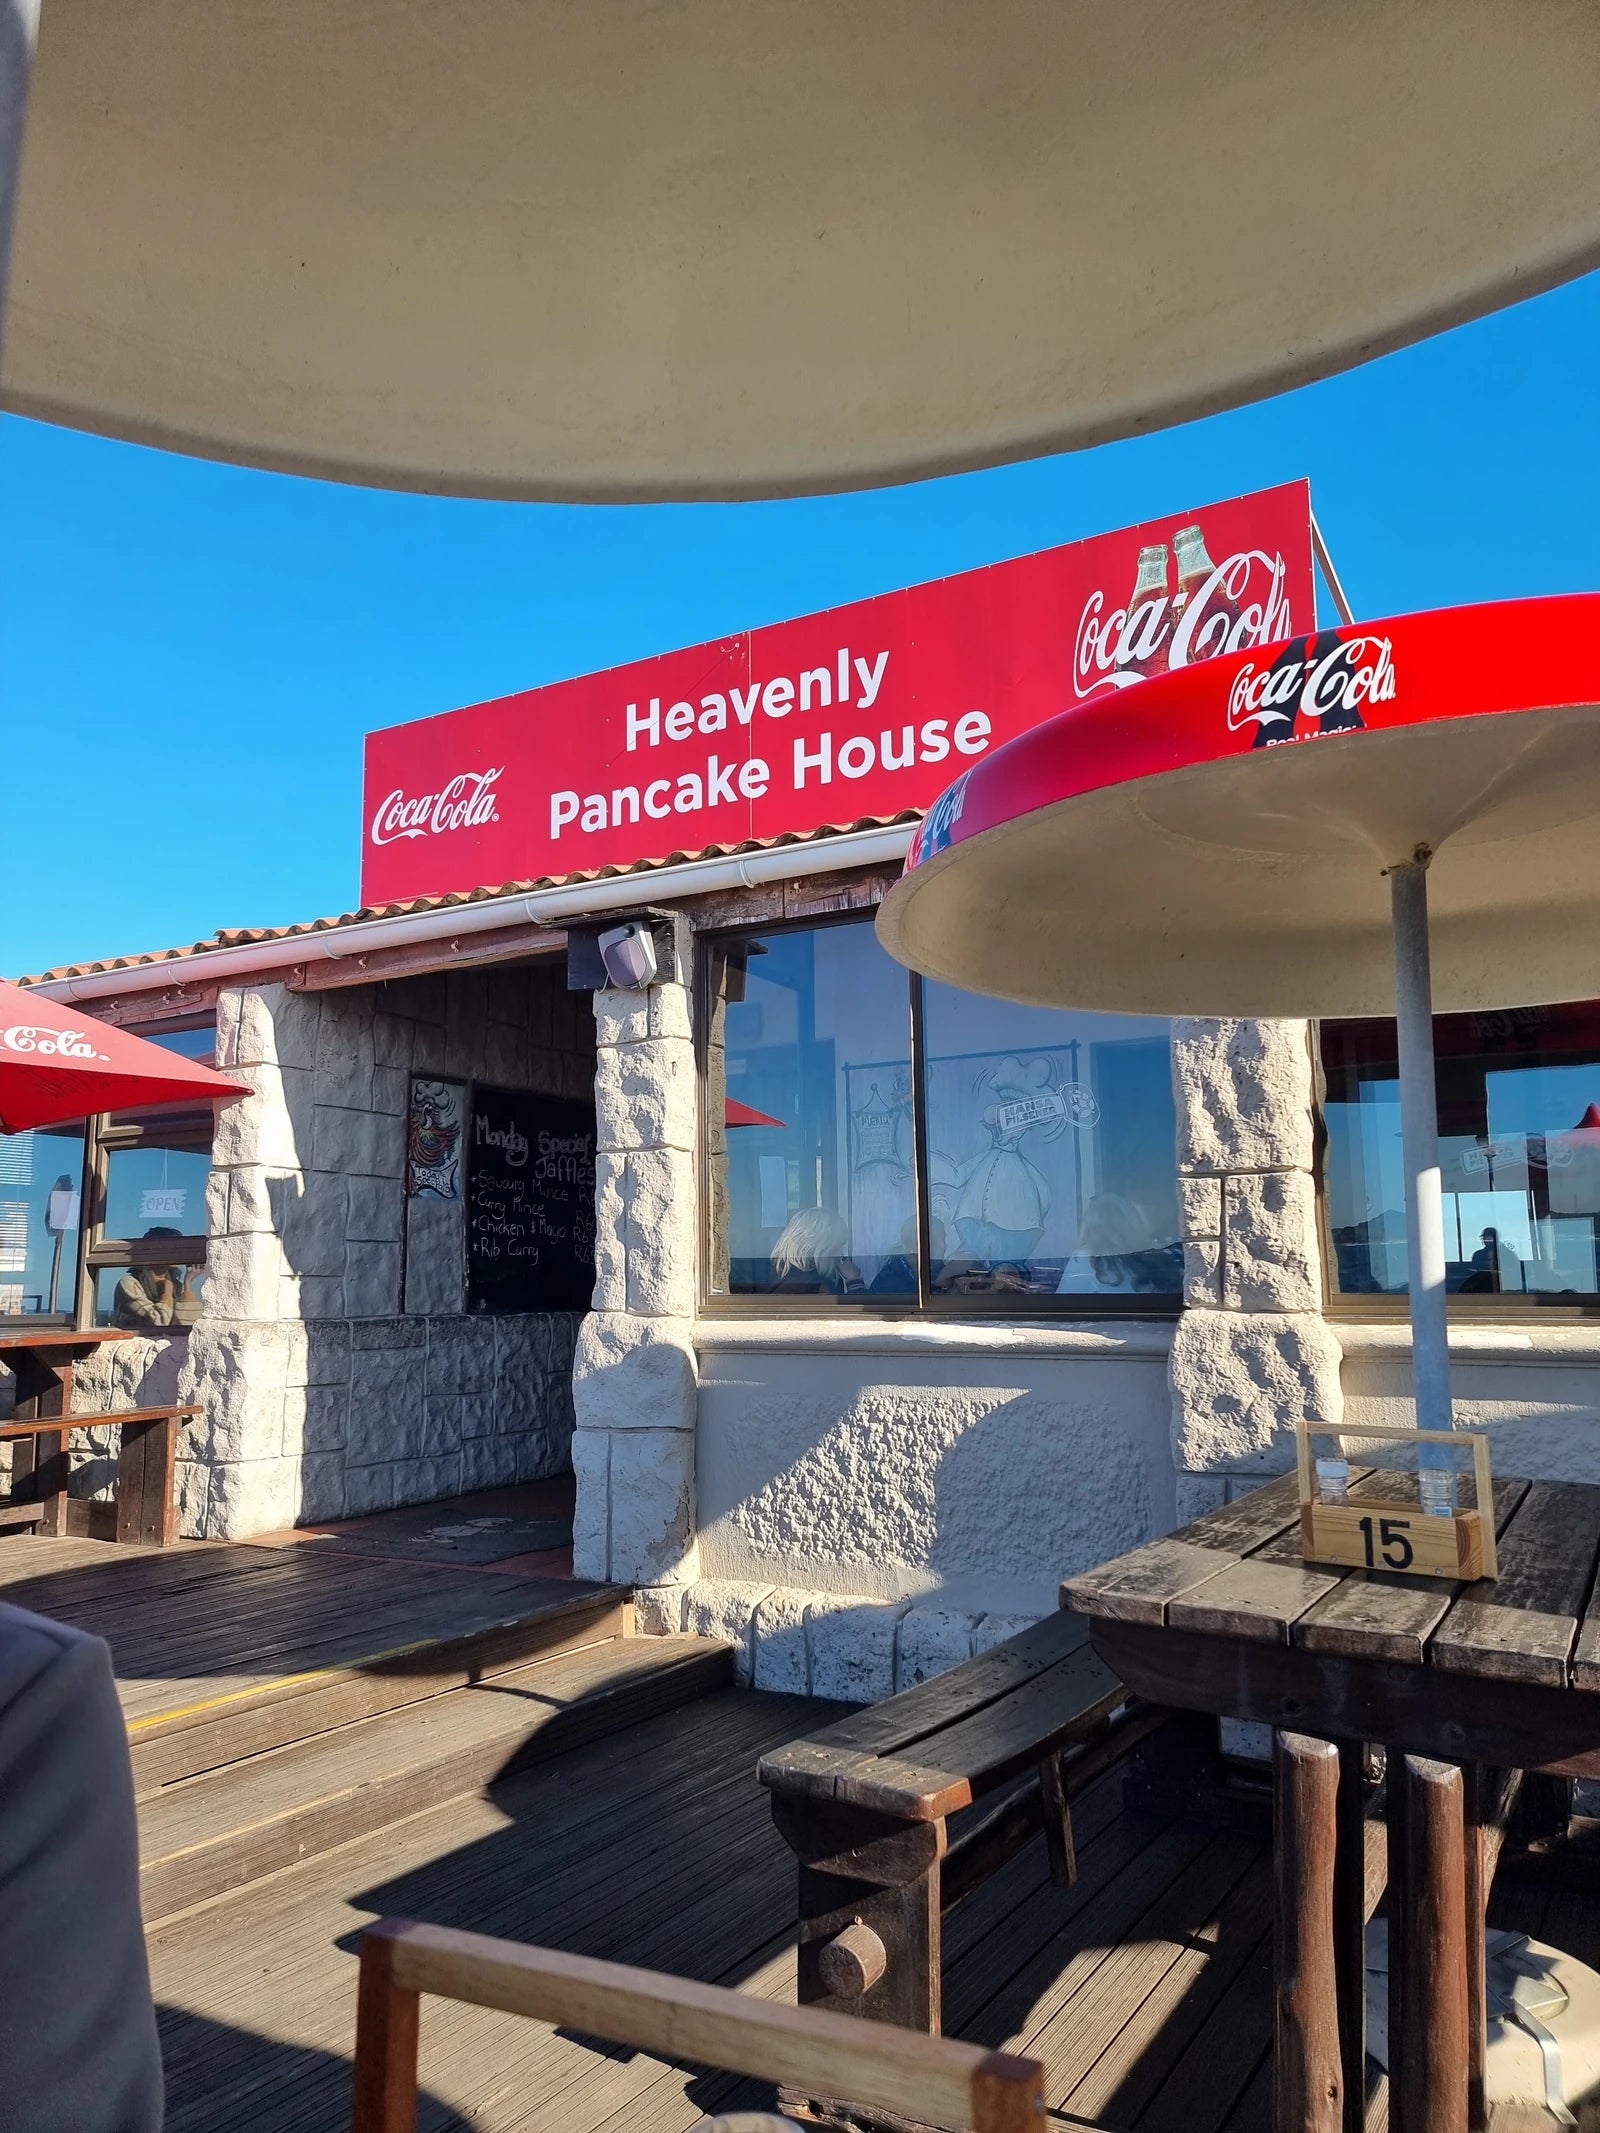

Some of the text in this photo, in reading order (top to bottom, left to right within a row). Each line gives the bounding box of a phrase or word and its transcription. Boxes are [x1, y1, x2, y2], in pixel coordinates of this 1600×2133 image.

[1073, 550, 1292, 698] Coca-Cola
[625, 647, 889, 753] Heavenly
[1227, 637, 1397, 732] Coca-Cola
[549, 709, 992, 840] Pancake House
[371, 765, 505, 846] Coca-Cola
[1004, 1098, 1055, 1118] HANSA
[476, 1114, 529, 1167] Monday
[532, 1178, 569, 1201] Mince
[534, 1155, 595, 1185] Jaffles
[146, 1197, 181, 1211] OPEN
[477, 1190, 506, 1220] Curry
[477, 1214, 525, 1236] Chicken
[480, 1236, 501, 1258] Rib
[507, 1238, 540, 1267] Curry
[1359, 1516, 1414, 1570] 15
